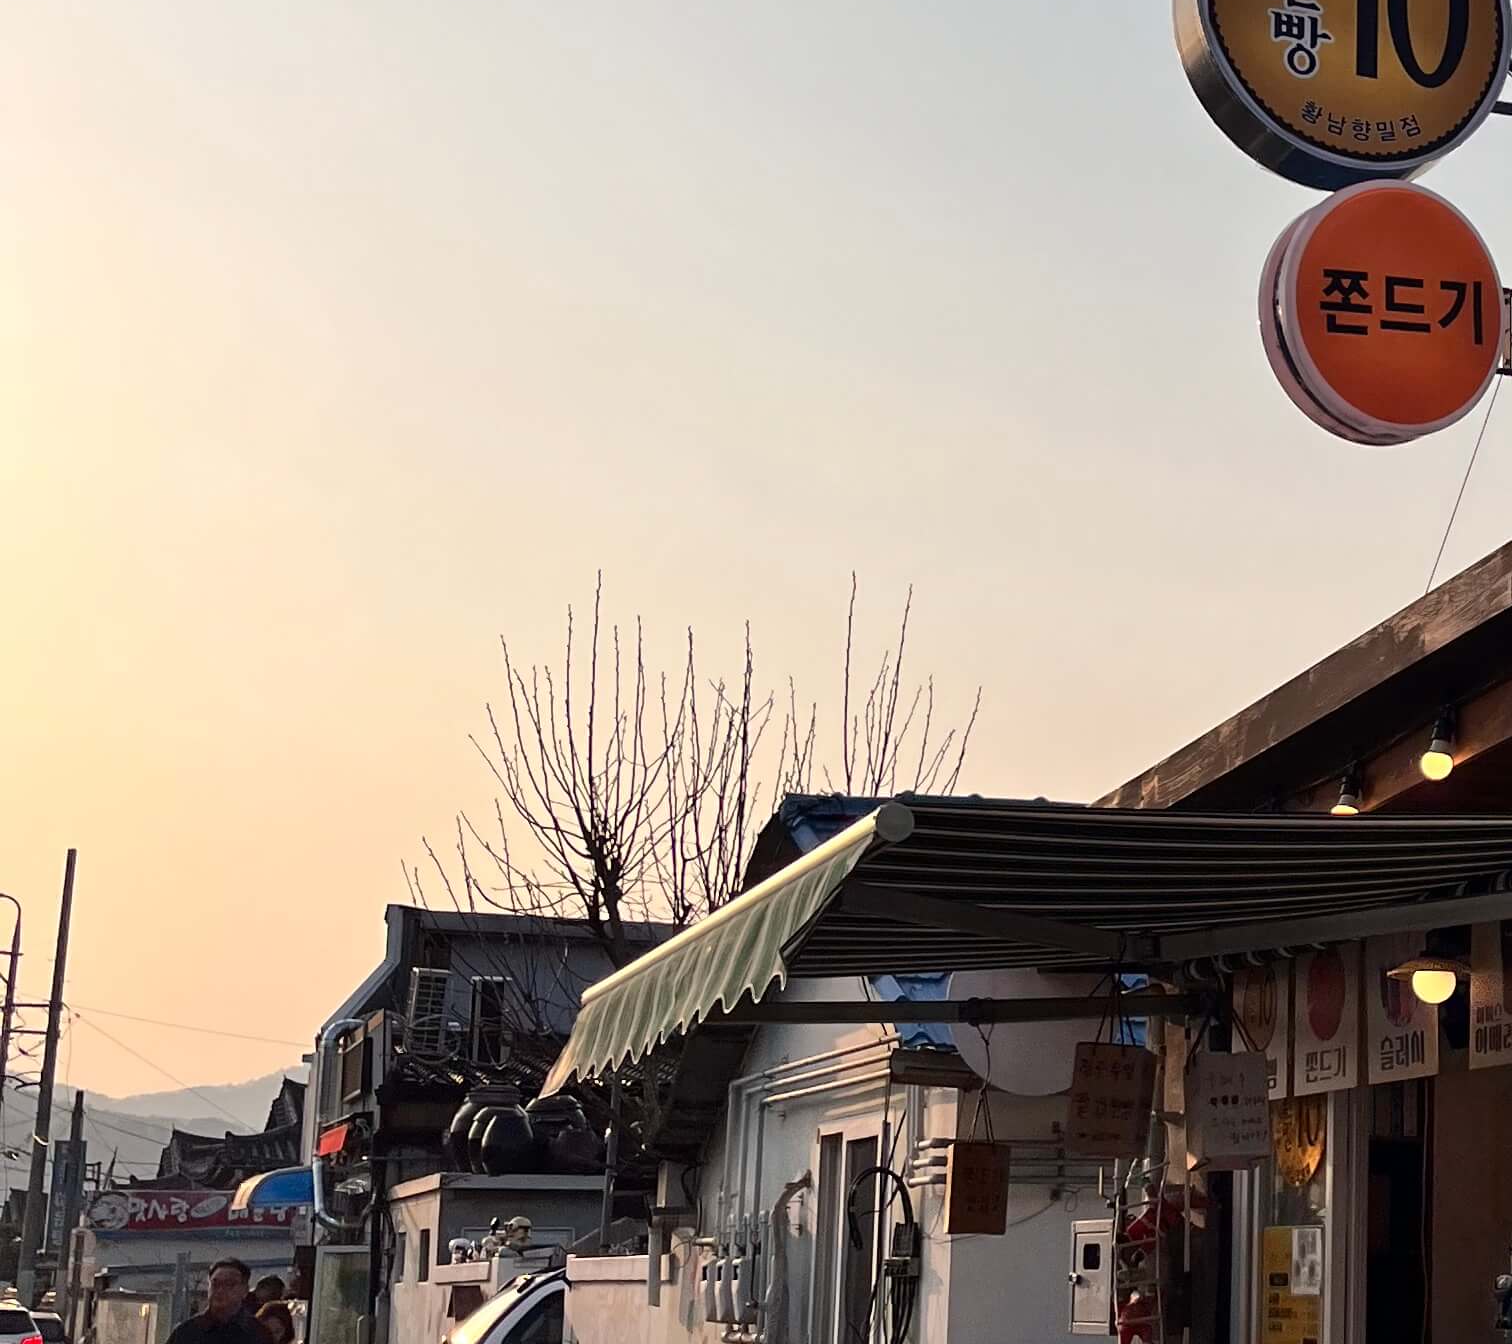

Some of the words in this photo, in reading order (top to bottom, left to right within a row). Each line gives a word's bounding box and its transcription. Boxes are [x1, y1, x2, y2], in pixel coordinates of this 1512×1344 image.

[1317, 268, 1485, 345] 쫀드기
[1305, 1044, 1347, 1084] 쫀드기
[1380, 1030, 1425, 1071] 슬러시
